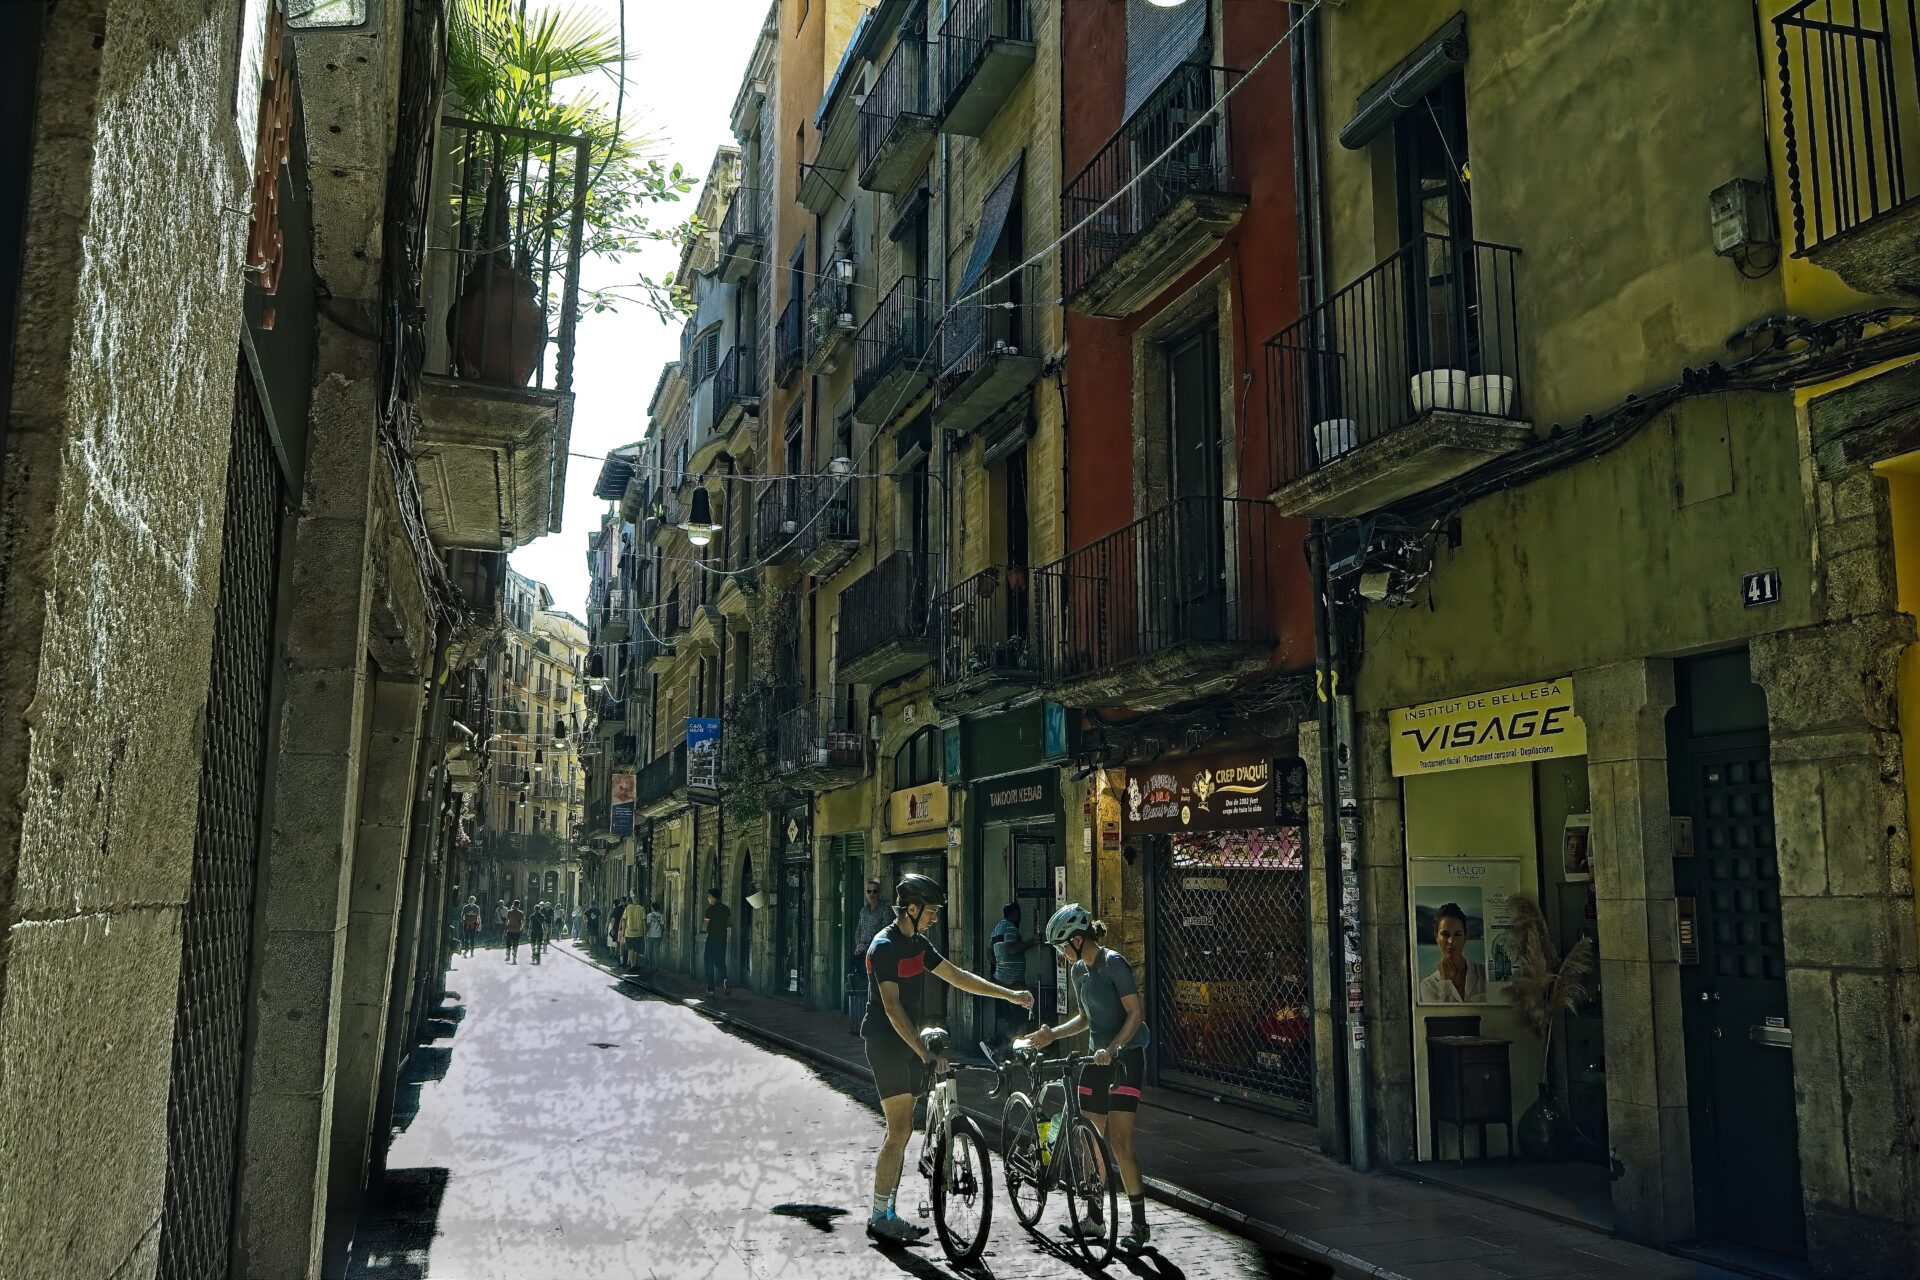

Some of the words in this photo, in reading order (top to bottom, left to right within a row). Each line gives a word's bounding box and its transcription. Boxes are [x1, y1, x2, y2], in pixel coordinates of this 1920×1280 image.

[1748, 574, 1772, 601] 41
[1405, 702, 1461, 720] INSTITUT
[1468, 698, 1484, 709] DE
[1492, 686, 1561, 705] BELLESA
[1402, 705, 1570, 752] VISAGE
[1464, 752, 1493, 763] Tractament
[1494, 749, 1516, 760] corporal
[1521, 745, 1553, 756] Depilacions
[1216, 768, 1234, 783] CREP
[1236, 759, 1268, 782] D'AQUÍ!
[990, 789, 1018, 807] TANDORI
[1019, 784, 1042, 802] KEBAB
[1447, 864, 1486, 875] THALGO
